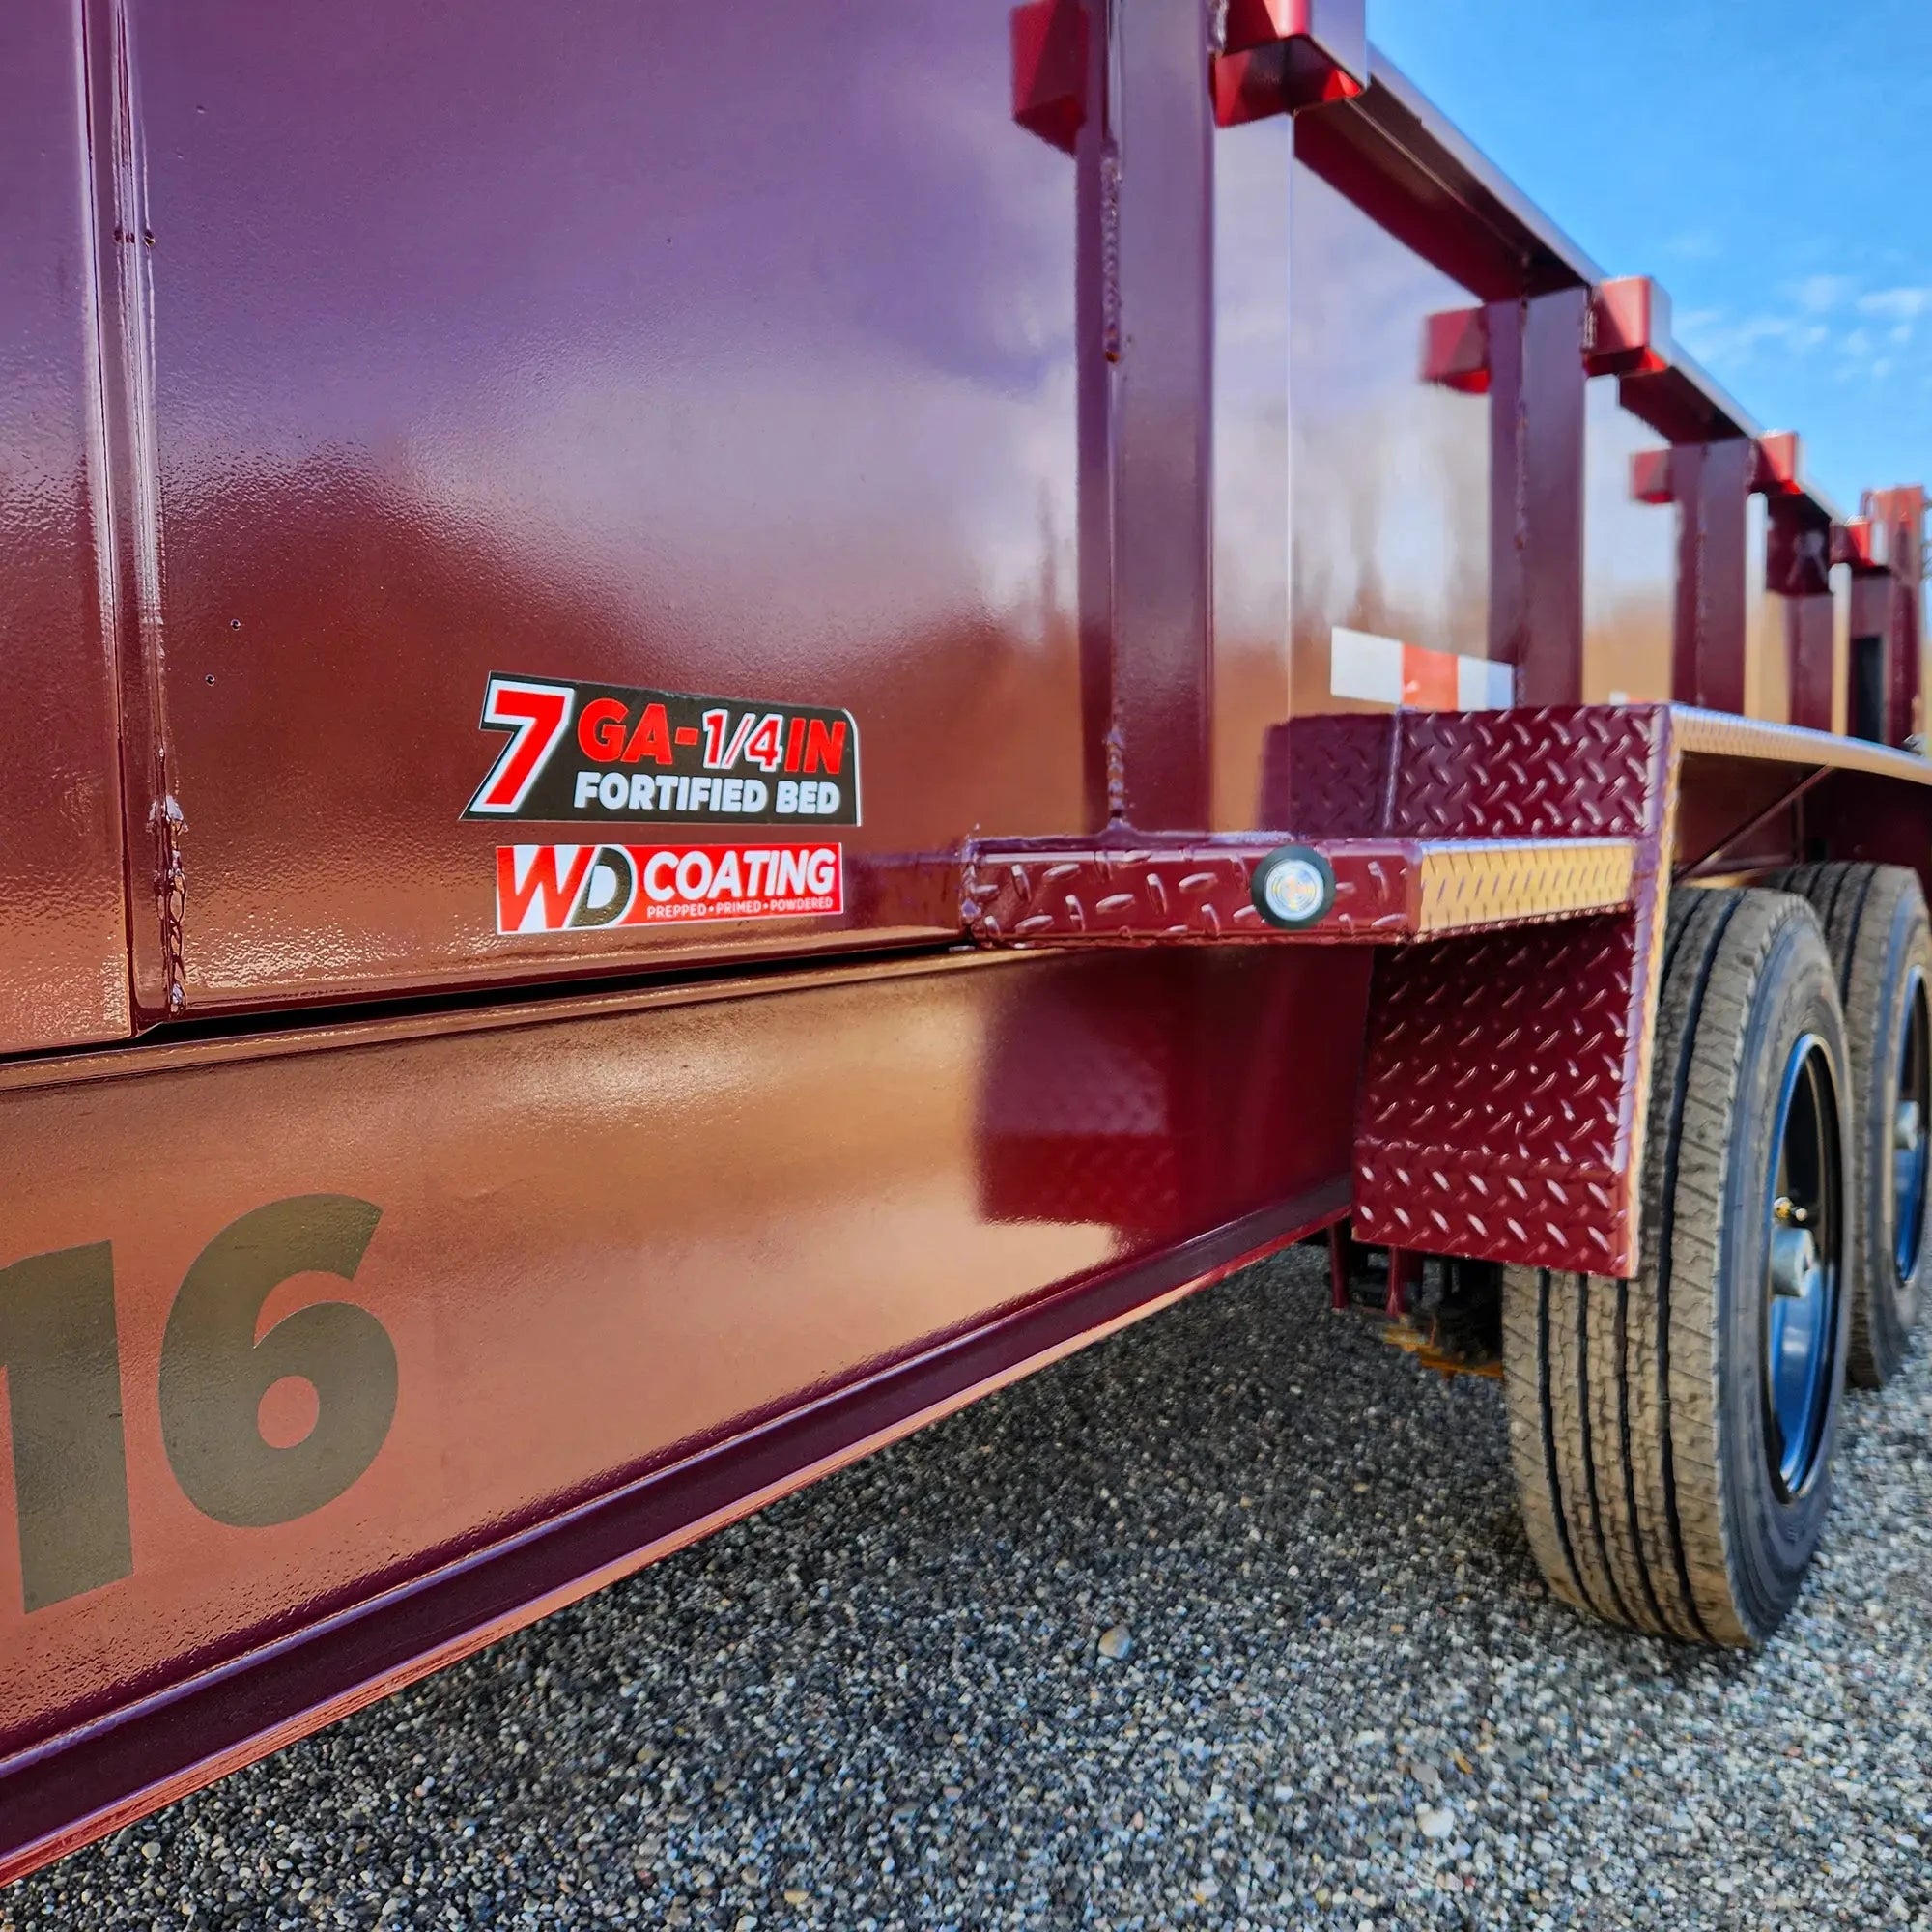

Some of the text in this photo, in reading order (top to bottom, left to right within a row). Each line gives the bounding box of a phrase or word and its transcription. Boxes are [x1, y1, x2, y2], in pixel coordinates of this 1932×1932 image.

[469, 679, 575, 813] 7
[574, 771, 841, 814] FORTIFIED BED
[497, 845, 836, 933] WD COATING
[646, 897, 834, 918] PREPPED PRIMED POWDERED
[0, 1193, 398, 1614] 16
